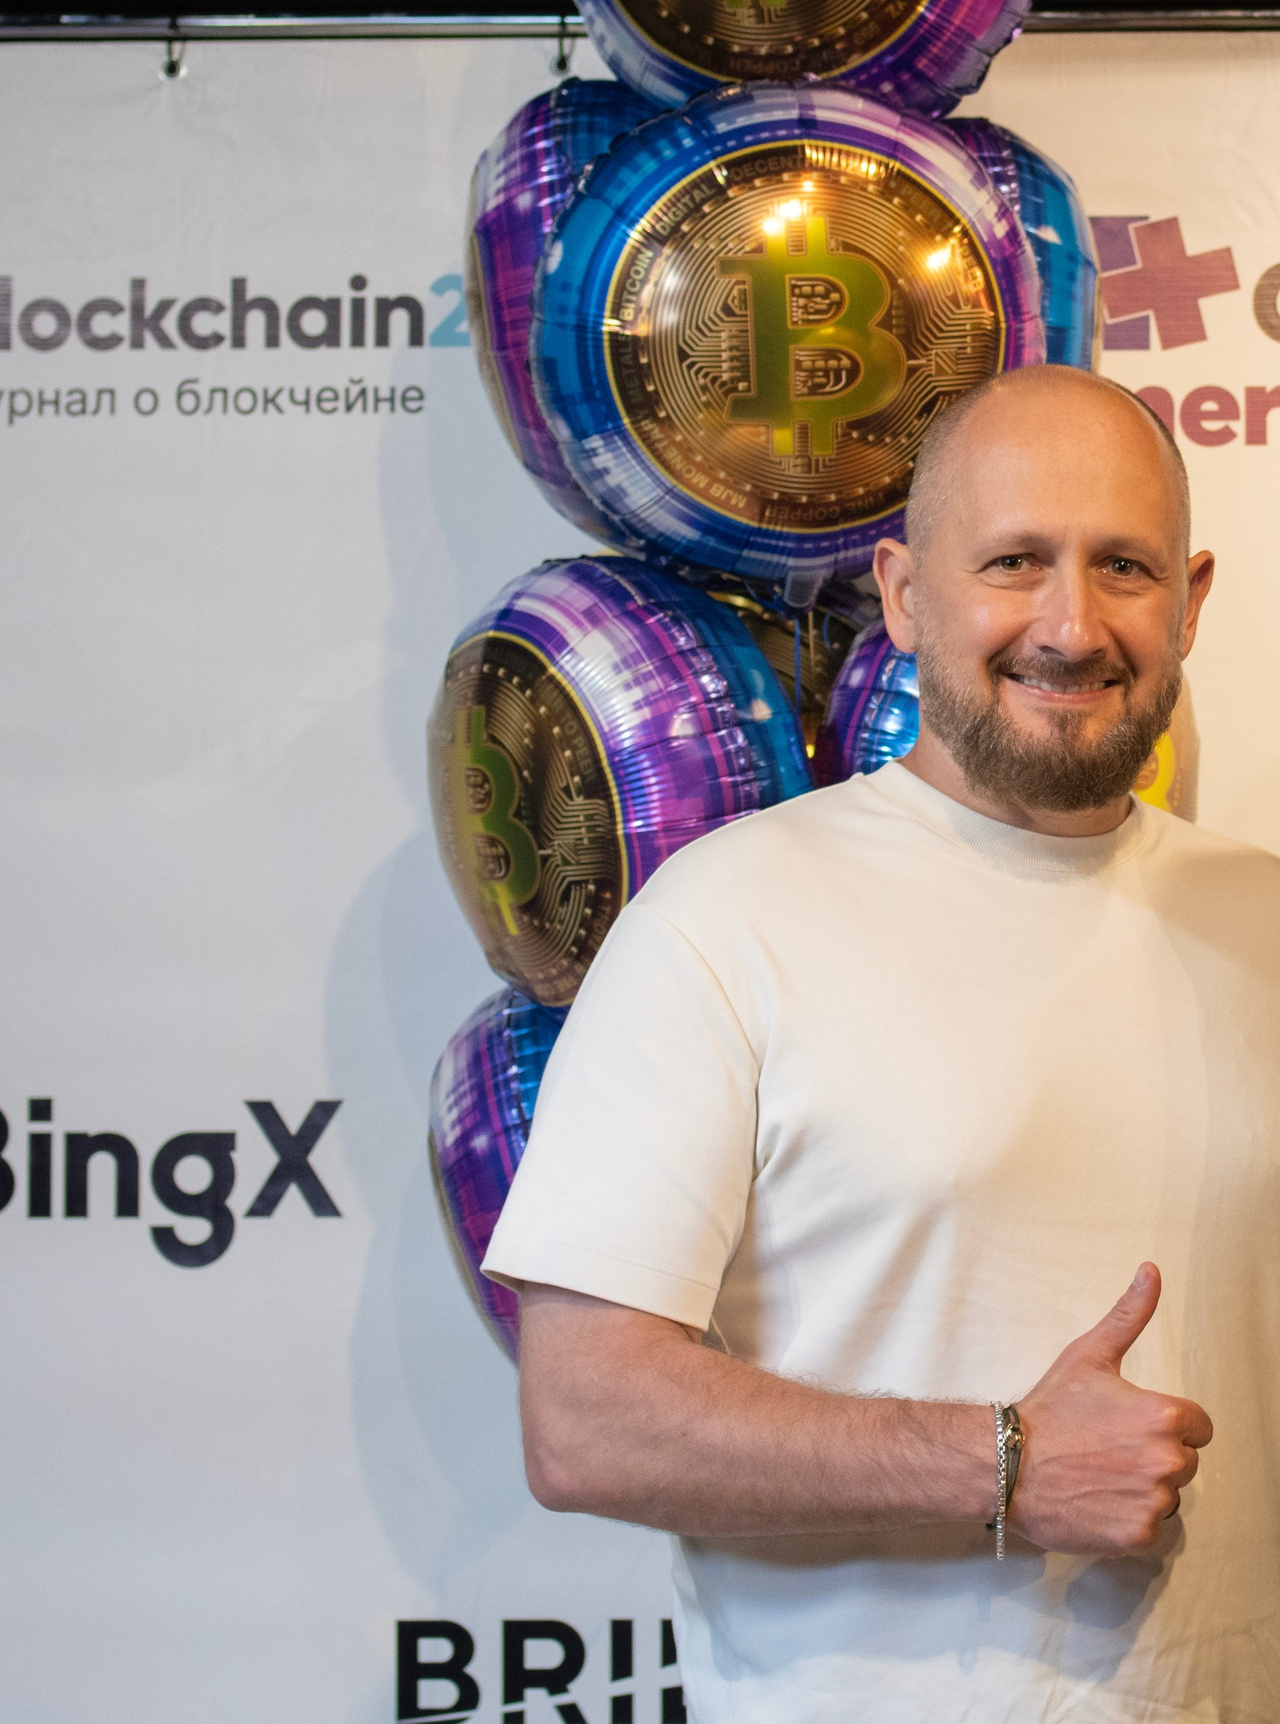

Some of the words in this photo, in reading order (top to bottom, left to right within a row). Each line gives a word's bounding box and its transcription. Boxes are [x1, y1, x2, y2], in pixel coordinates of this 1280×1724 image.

[619, 249, 654, 321] BITCOIN
[655, 181, 718, 237] DIGITAL
[0, 388, 115, 425] рнал
[176, 379, 425, 416] блокчейне
[633, 406, 710, 490] MONETARY
[707, 481, 747, 510] MJB
[0, 1097, 343, 1269] ingX
